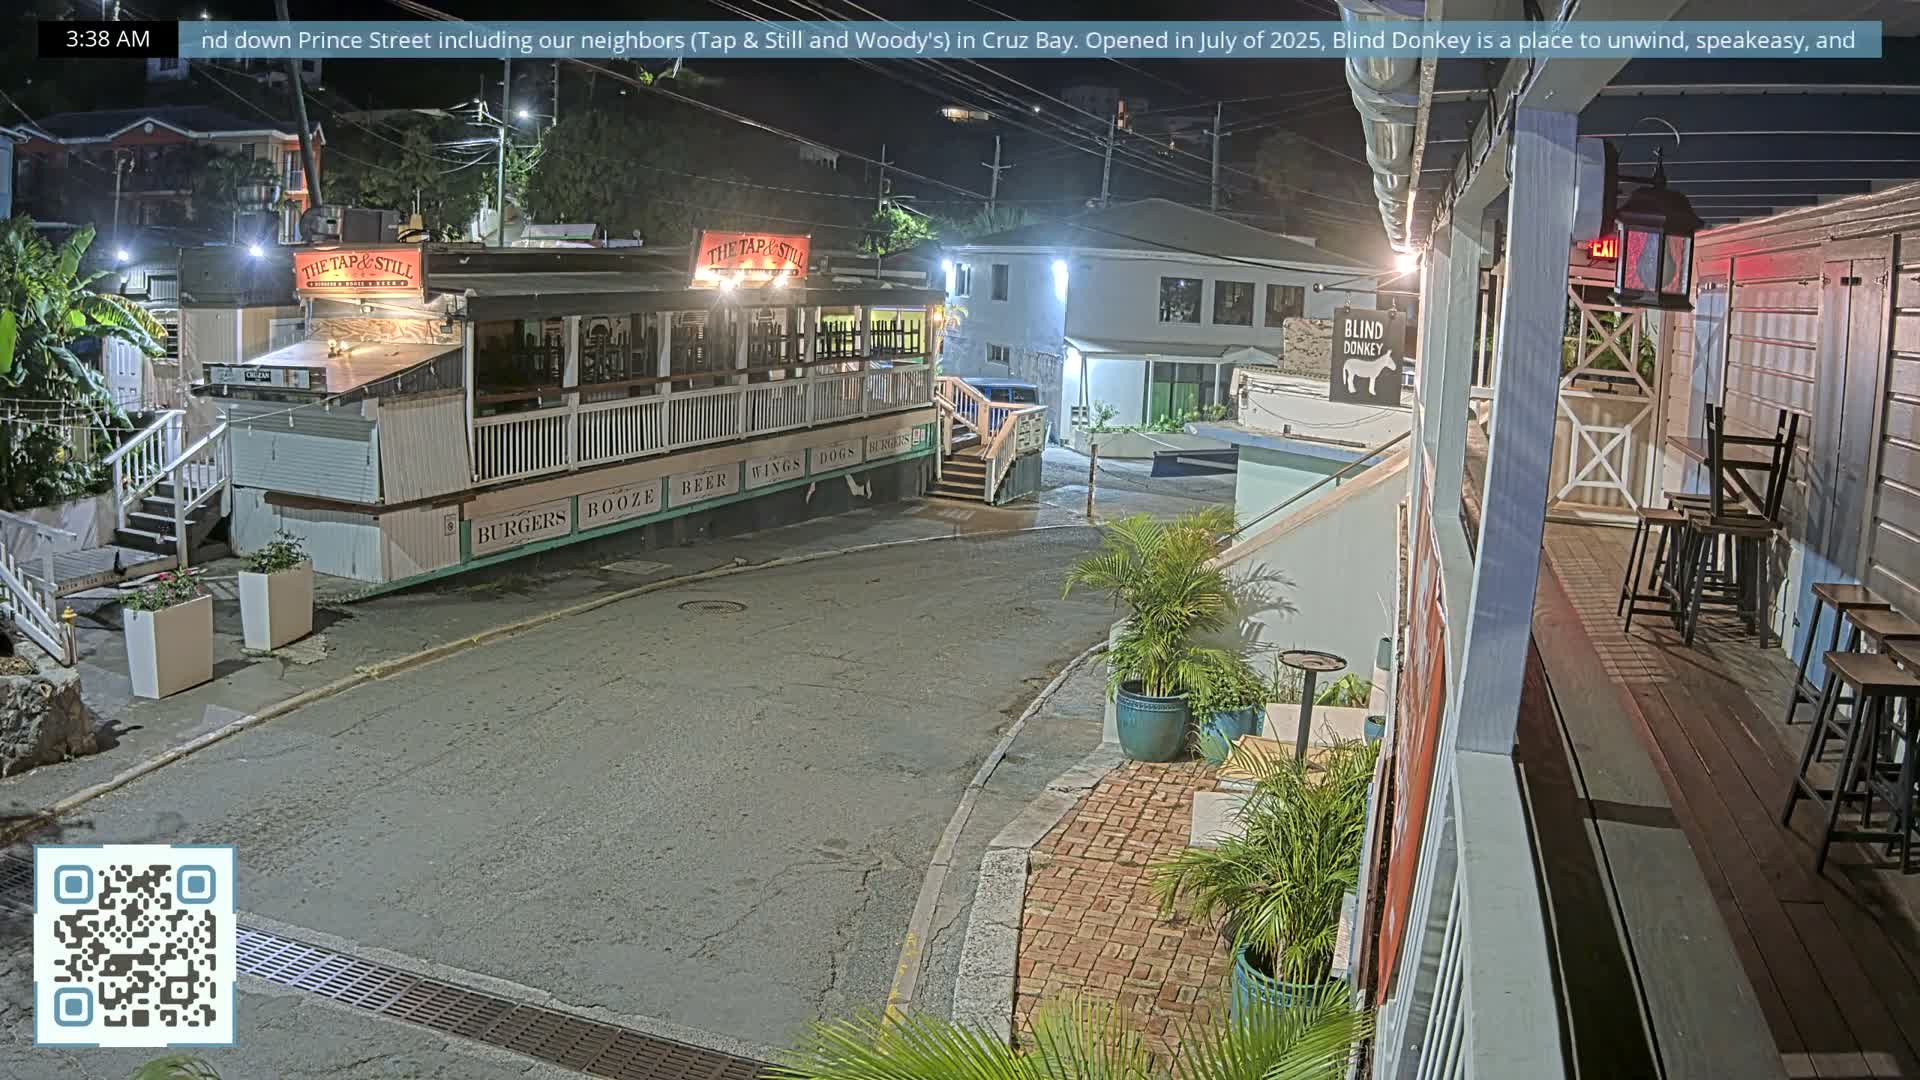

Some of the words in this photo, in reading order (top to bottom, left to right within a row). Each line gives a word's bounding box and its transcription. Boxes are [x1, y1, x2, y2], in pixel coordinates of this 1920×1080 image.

[708, 241, 738, 265] THE
[739, 238, 765, 256] TAP
[778, 241, 803, 268] STILL
[302, 259, 329, 280] THE
[330, 255, 358, 270] TAP
[374, 256, 414, 279] STILL
[1344, 319, 1384, 340] BLIND
[1343, 341, 1384, 356] DONKEY
[868, 434, 910, 454] BURGERS
[820, 447, 855, 465] DOGS
[751, 457, 801, 478] WINGS
[682, 473, 727, 496] BEER
[587, 488, 654, 518] BOOZE
[478, 509, 567, 545] BURGERS
